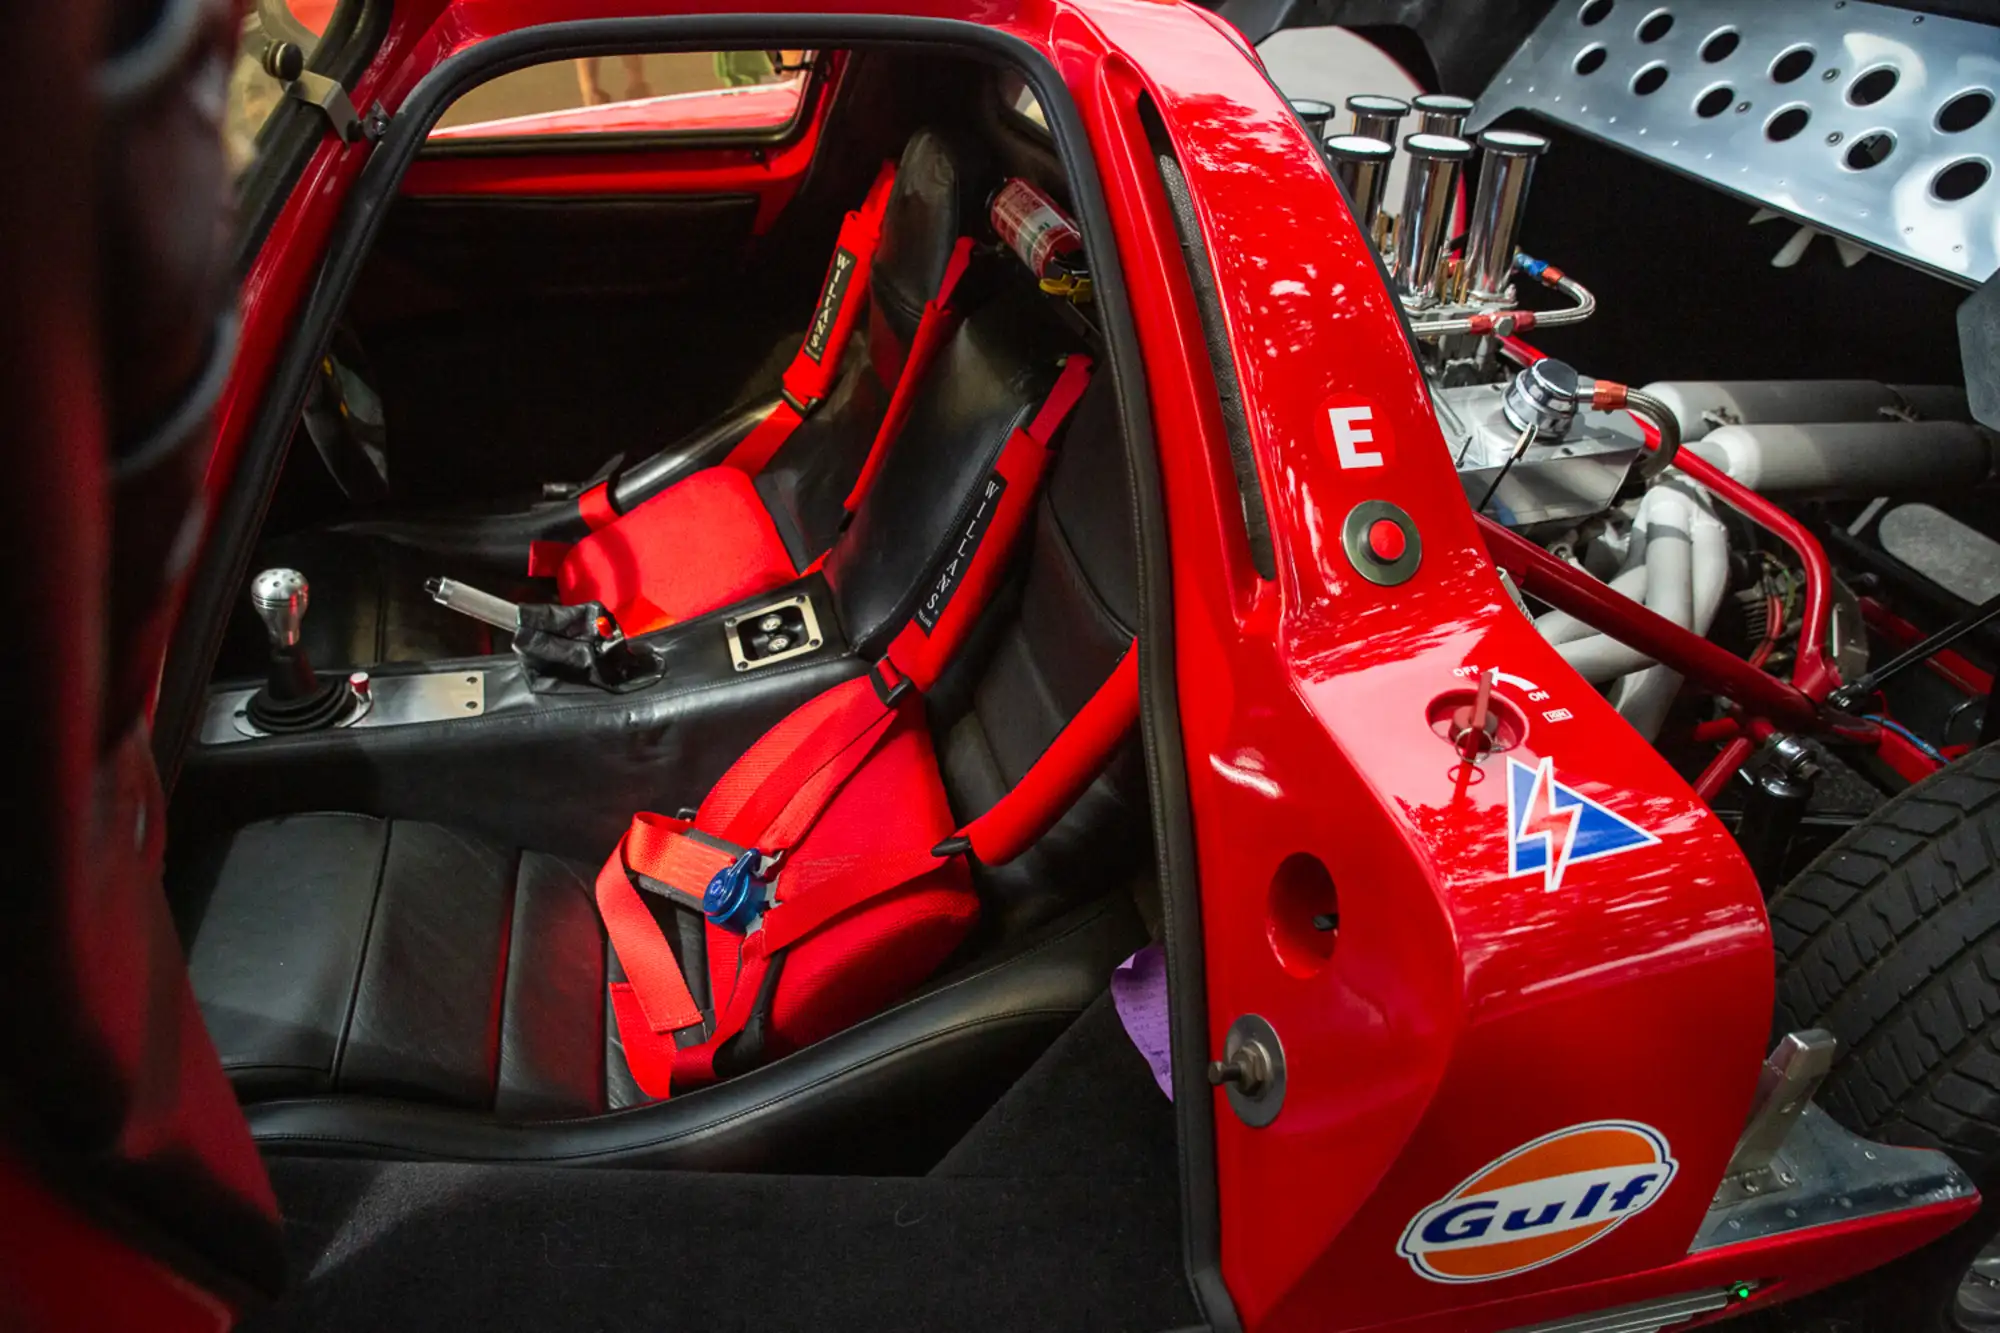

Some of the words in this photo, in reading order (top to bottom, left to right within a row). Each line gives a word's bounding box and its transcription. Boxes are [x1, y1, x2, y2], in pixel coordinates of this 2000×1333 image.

[1328, 406, 1384, 469] E
[926, 480, 999, 609] WILLANS
[1452, 665, 1479, 677] OFF
[1528, 690, 1550, 702] ON
[1421, 1173, 1659, 1244] Gulf
